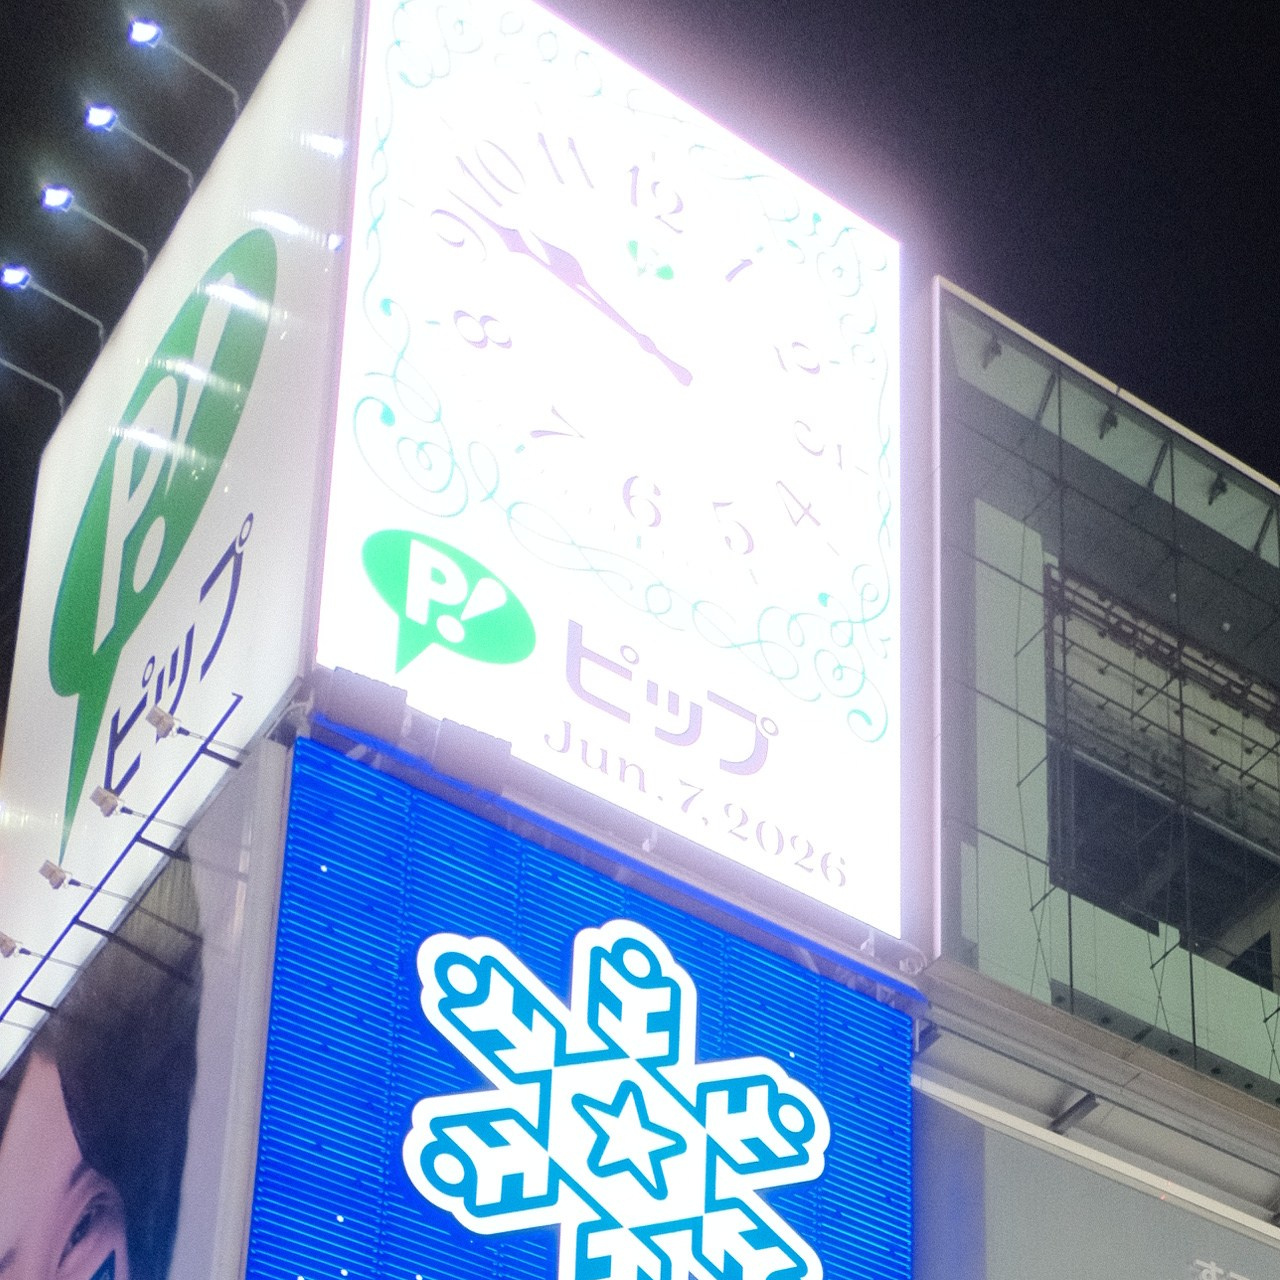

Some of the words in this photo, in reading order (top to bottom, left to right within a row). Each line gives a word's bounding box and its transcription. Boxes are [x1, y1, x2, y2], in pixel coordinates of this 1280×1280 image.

[455, 138, 526, 208] 10
[627, 165, 684, 234] 12
[452, 309, 513, 350] 8
[775, 480, 822, 527] 4
[565, 618, 780, 777] ピップ
[723, 802, 848, 889] 2026
